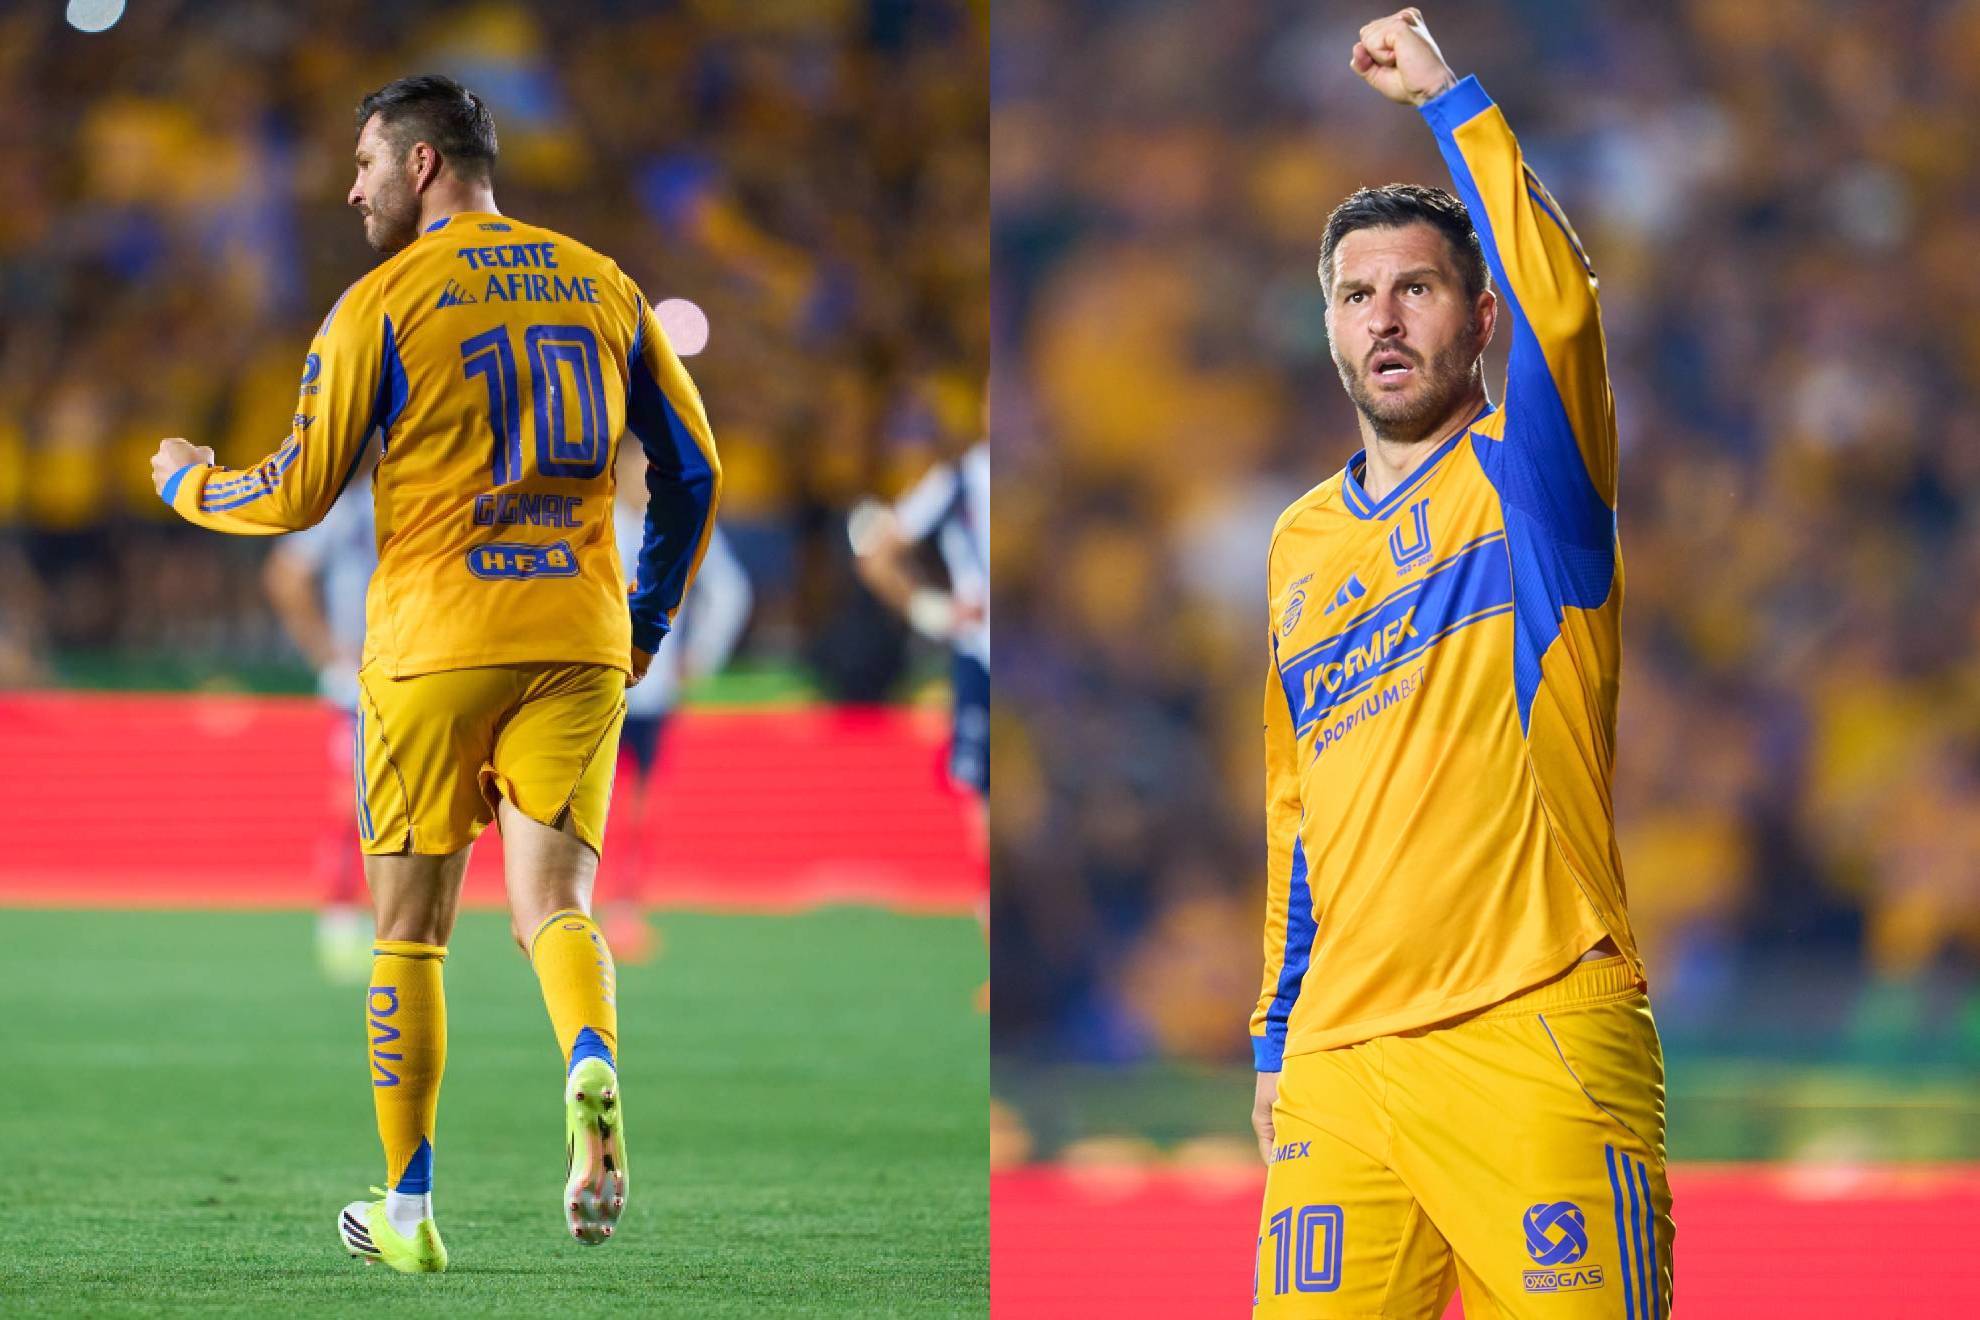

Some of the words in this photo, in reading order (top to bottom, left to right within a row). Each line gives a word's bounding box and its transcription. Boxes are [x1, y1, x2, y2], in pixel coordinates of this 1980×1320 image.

[457, 242, 559, 270] TECATE
[485, 273, 600, 304] AFIRME
[460, 323, 609, 487] 10
[481, 549, 569, 572] H-E-B
[369, 986, 403, 1086] viva
[1269, 1204, 1344, 1295] 10
